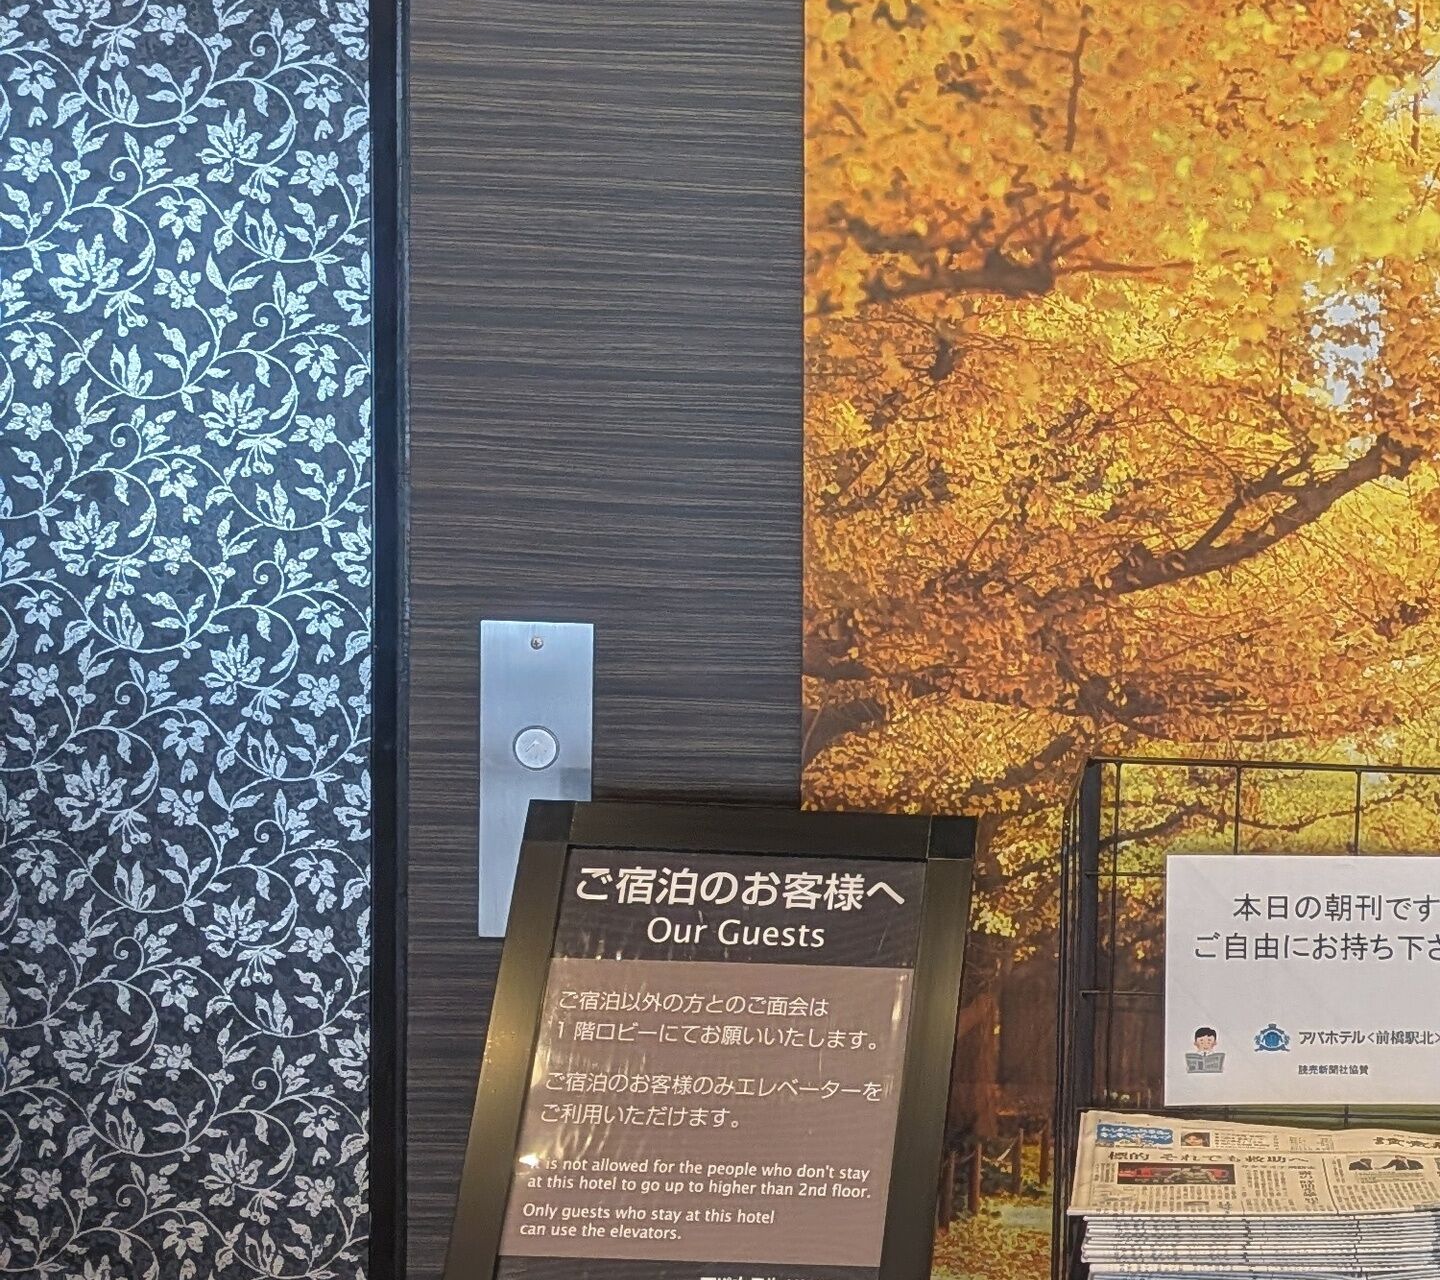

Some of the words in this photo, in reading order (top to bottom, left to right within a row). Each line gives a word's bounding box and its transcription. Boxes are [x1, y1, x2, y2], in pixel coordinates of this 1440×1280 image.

[576, 865, 906, 912] ご宿泊のお客様へ
[647, 916, 709, 944] Our
[717, 919, 826, 948] Guests
[558, 990, 829, 1018] ご宿泊以外の方とのご面会は
[545, 1071, 883, 1102] ご宿泊のお客様のみエレベーターを
[540, 1103, 740, 1129] ご利用いただけます。
[546, 1158, 558, 1170] is
[563, 1159, 588, 1171] not
[592, 1158, 648, 1172] allowed
[653, 1160, 675, 1173] for
[679, 1161, 703, 1175] the
[707, 1162, 757, 1178] people
[761, 1163, 792, 1177] who
[797, 1164, 835, 1179] don't
[840, 1167, 870, 1182] stay
[527, 1176, 542, 1189] at
[547, 1175, 574, 1189] this
[579, 1176, 616, 1191] hotel
[621, 1179, 636, 1191] to
[641, 1181, 660, 1195] go
[665, 1181, 683, 1195] up
[688, 1180, 704, 1193] to
[708, 1180, 755, 1198] higher
[761, 1182, 793, 1196] than
[798, 1182, 827, 1197] 2nd
[832, 1183, 871, 1199] floor.
[522, 1203, 557, 1220] Only
[561, 1205, 611, 1222] guests
[615, 1206, 647, 1220] who
[651, 1209, 682, 1224] stay
[685, 1209, 700, 1222] at
[705, 1208, 732, 1223] this
[737, 1209, 775, 1224] hotel
[520, 1225, 546, 1237] can
[551, 1226, 577, 1238] use
[582, 1224, 606, 1238] the
[610, 1225, 682, 1240] elevators.
